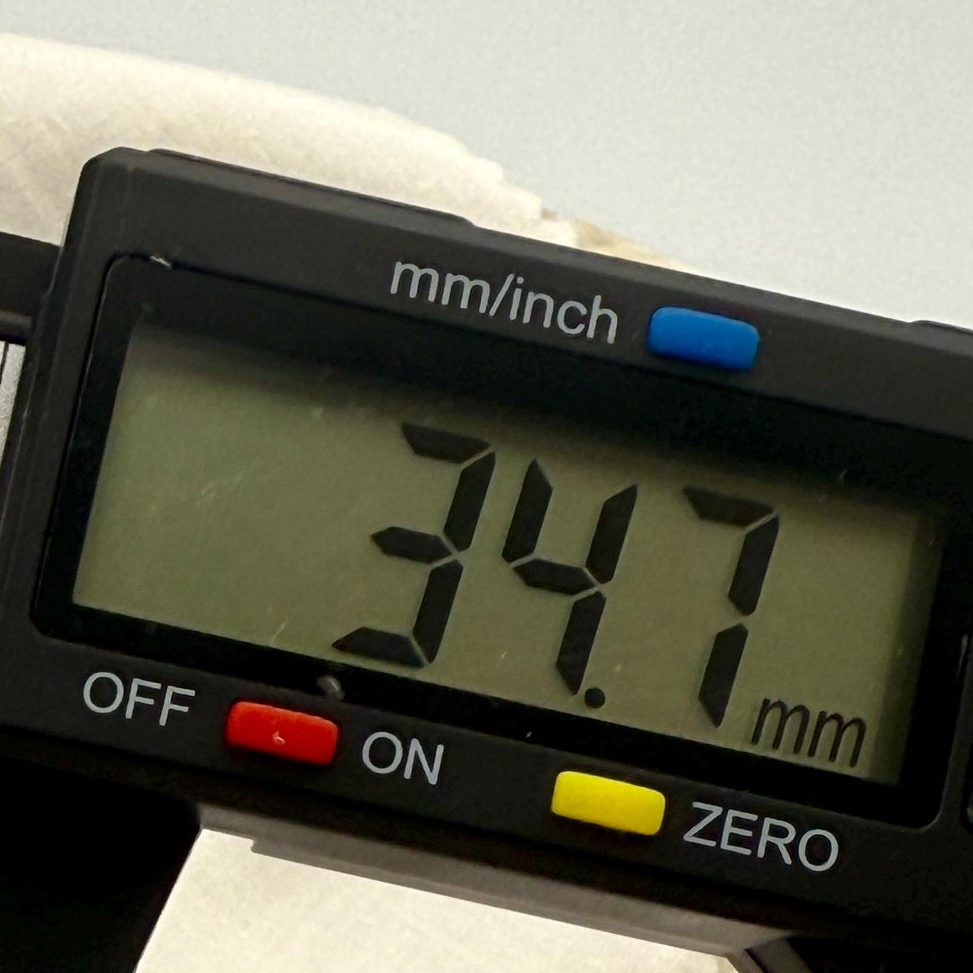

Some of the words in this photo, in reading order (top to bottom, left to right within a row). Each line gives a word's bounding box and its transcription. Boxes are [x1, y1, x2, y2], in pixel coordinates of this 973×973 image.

[391, 261, 619, 344] mm/inch
[333, 423, 780, 728] 34.7
[752, 697, 866, 768] mm
[82, 671, 196, 727] OFF
[361, 731, 444, 786] ON
[682, 802, 840, 872] ZERO
